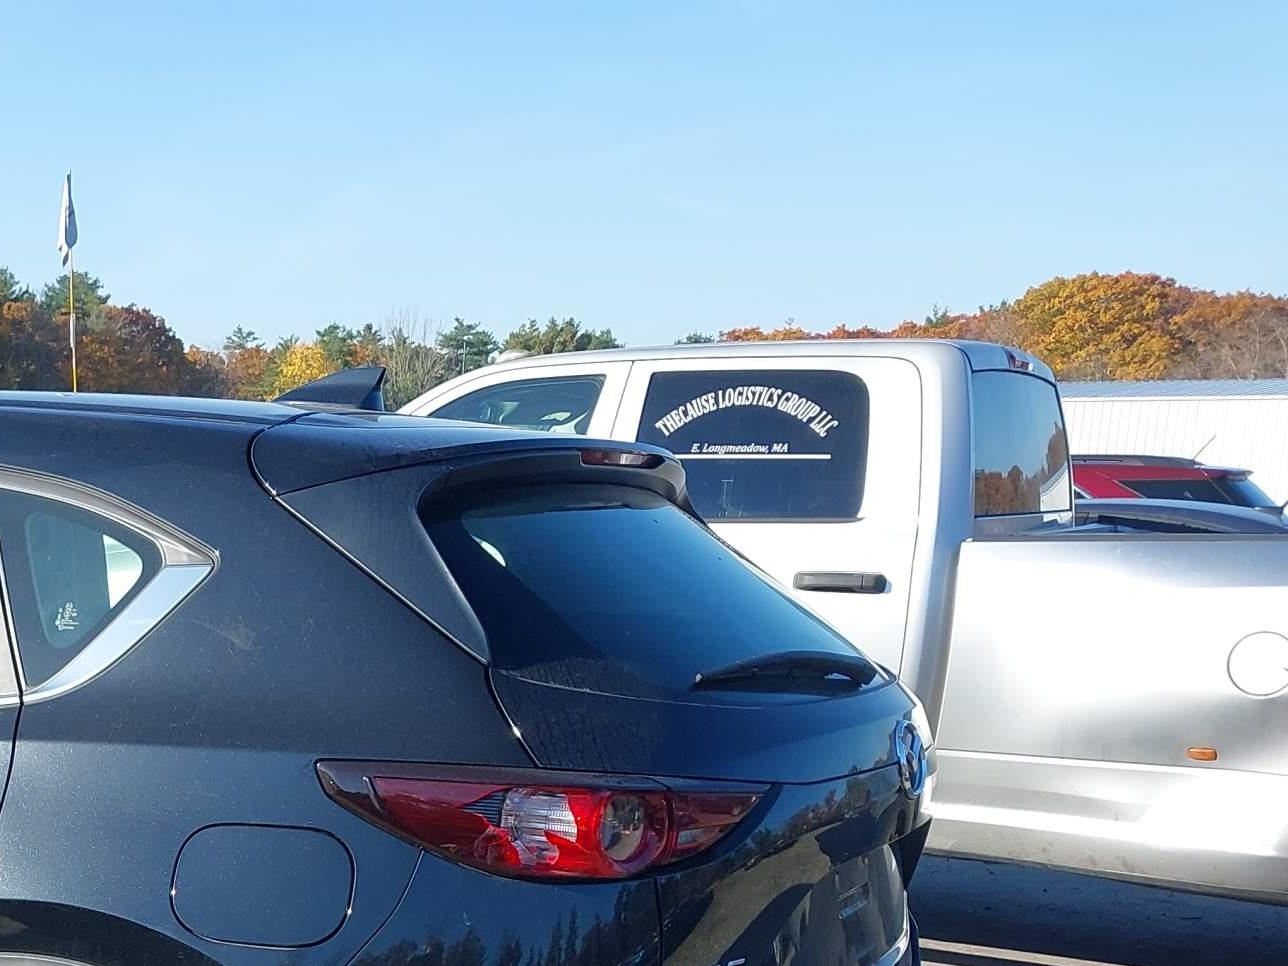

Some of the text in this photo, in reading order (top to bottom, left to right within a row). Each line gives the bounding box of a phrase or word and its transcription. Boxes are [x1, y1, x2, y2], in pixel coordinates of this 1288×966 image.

[655, 386, 840, 437] THECAUSE LOGISTICS GROUP LLC
[691, 443, 788, 455] E. Longmeadow, MA
